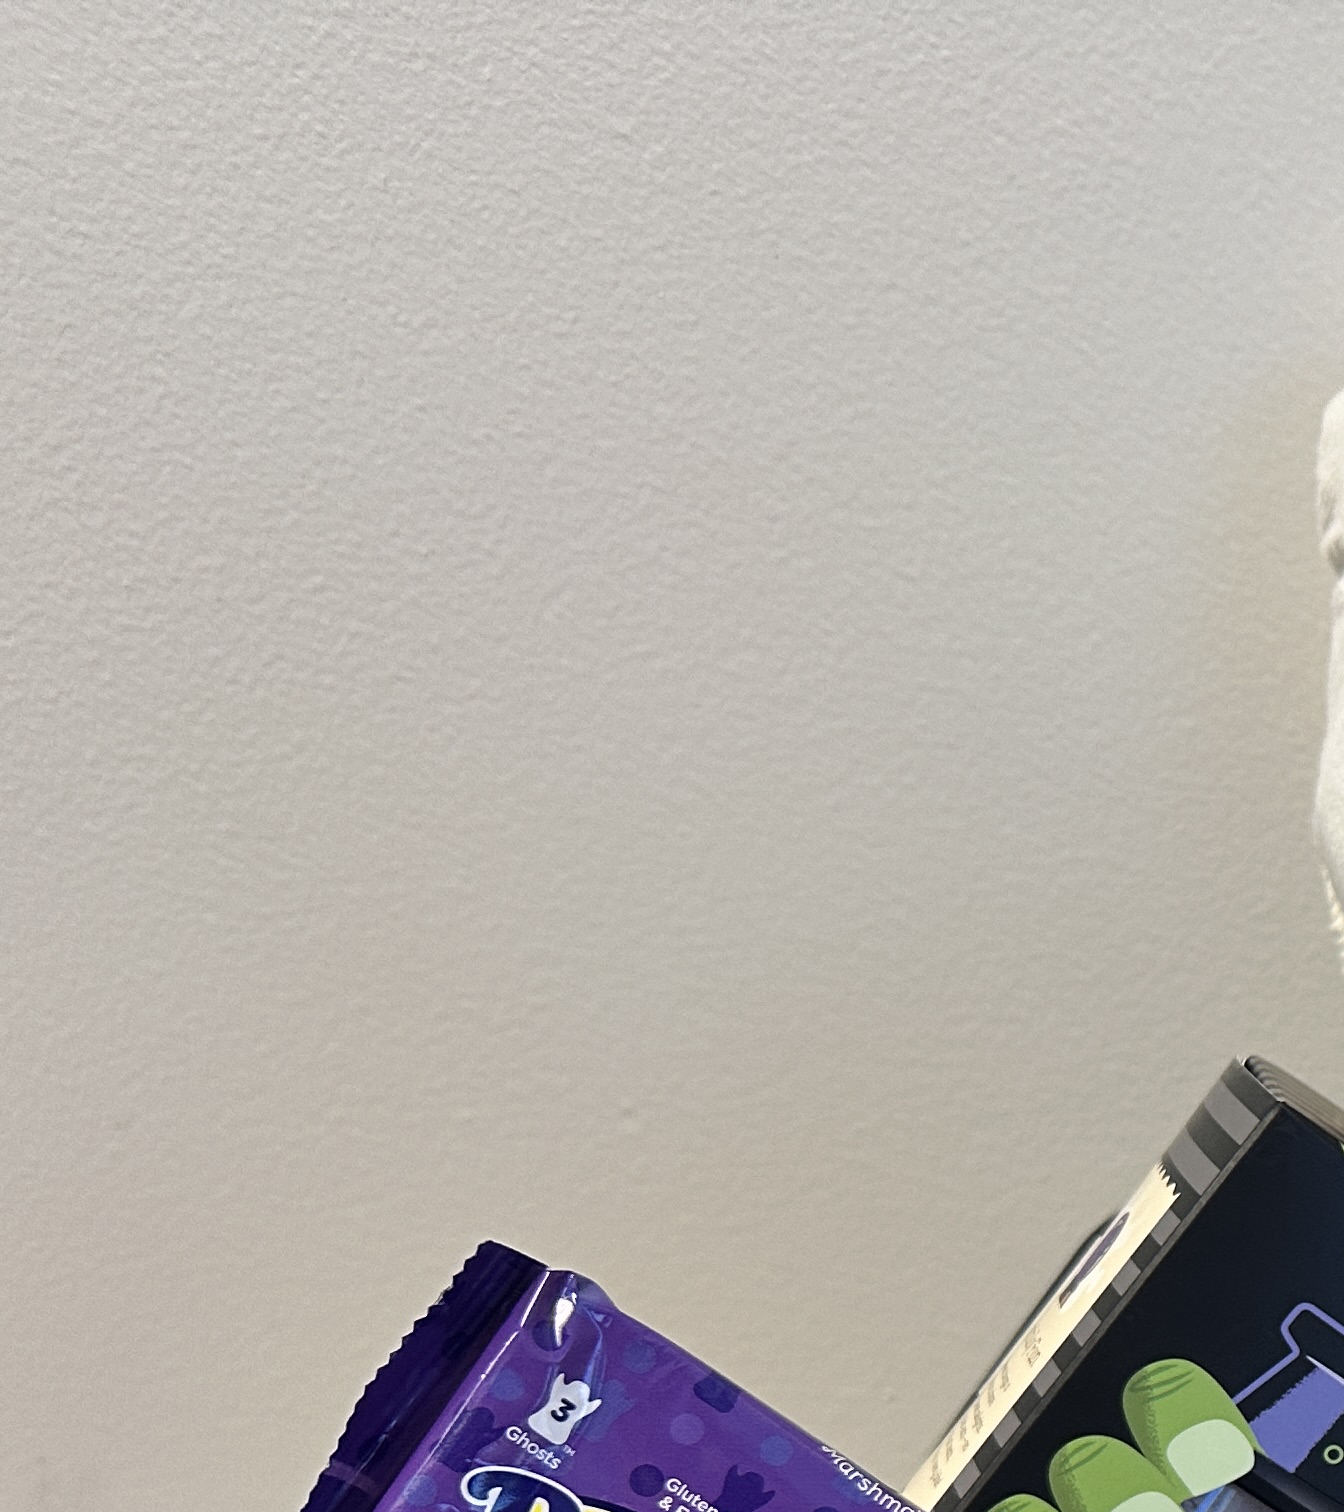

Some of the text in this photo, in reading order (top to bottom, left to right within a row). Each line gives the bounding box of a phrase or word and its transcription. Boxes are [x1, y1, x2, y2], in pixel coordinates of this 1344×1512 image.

[551, 1398, 576, 1422] 3
[506, 1425, 562, 1469] Ghosts
[658, 1496, 673, 1511] &
